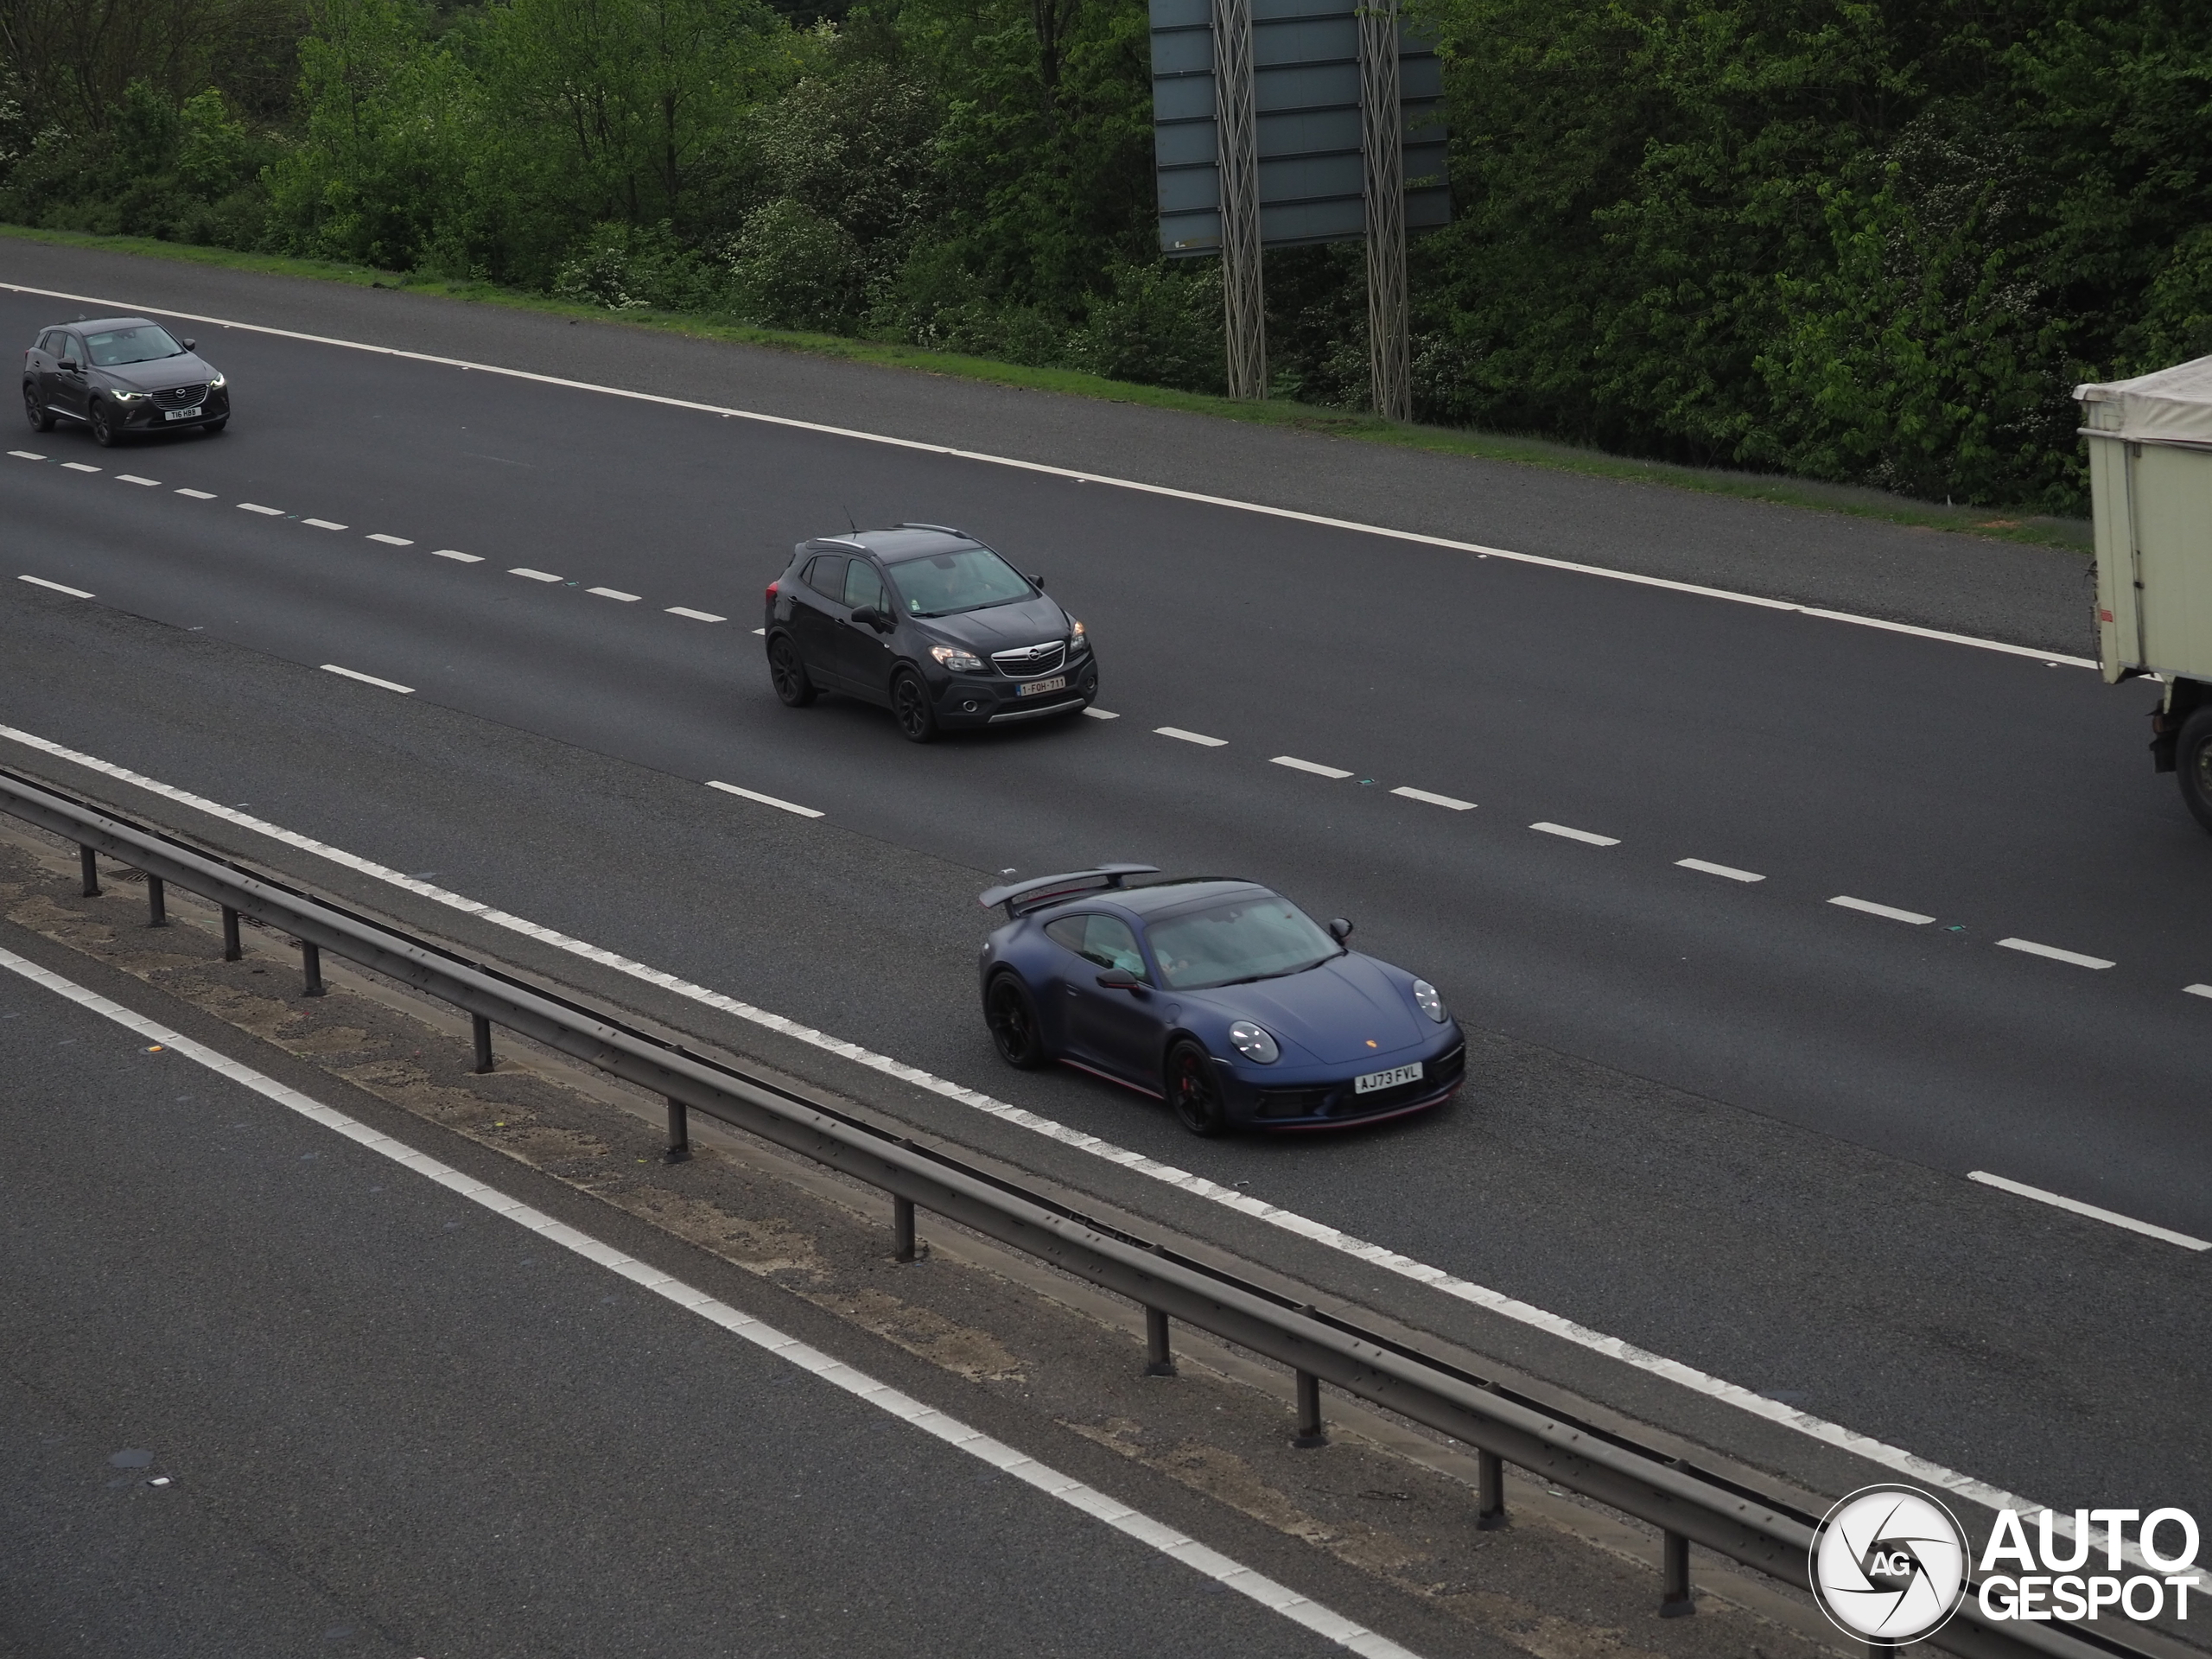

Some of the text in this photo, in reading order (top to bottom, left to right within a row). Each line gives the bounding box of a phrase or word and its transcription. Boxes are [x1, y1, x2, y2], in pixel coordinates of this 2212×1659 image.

[183, 409, 196, 417] HBB
[1361, 1065, 1418, 1090] AJ73 FVL
